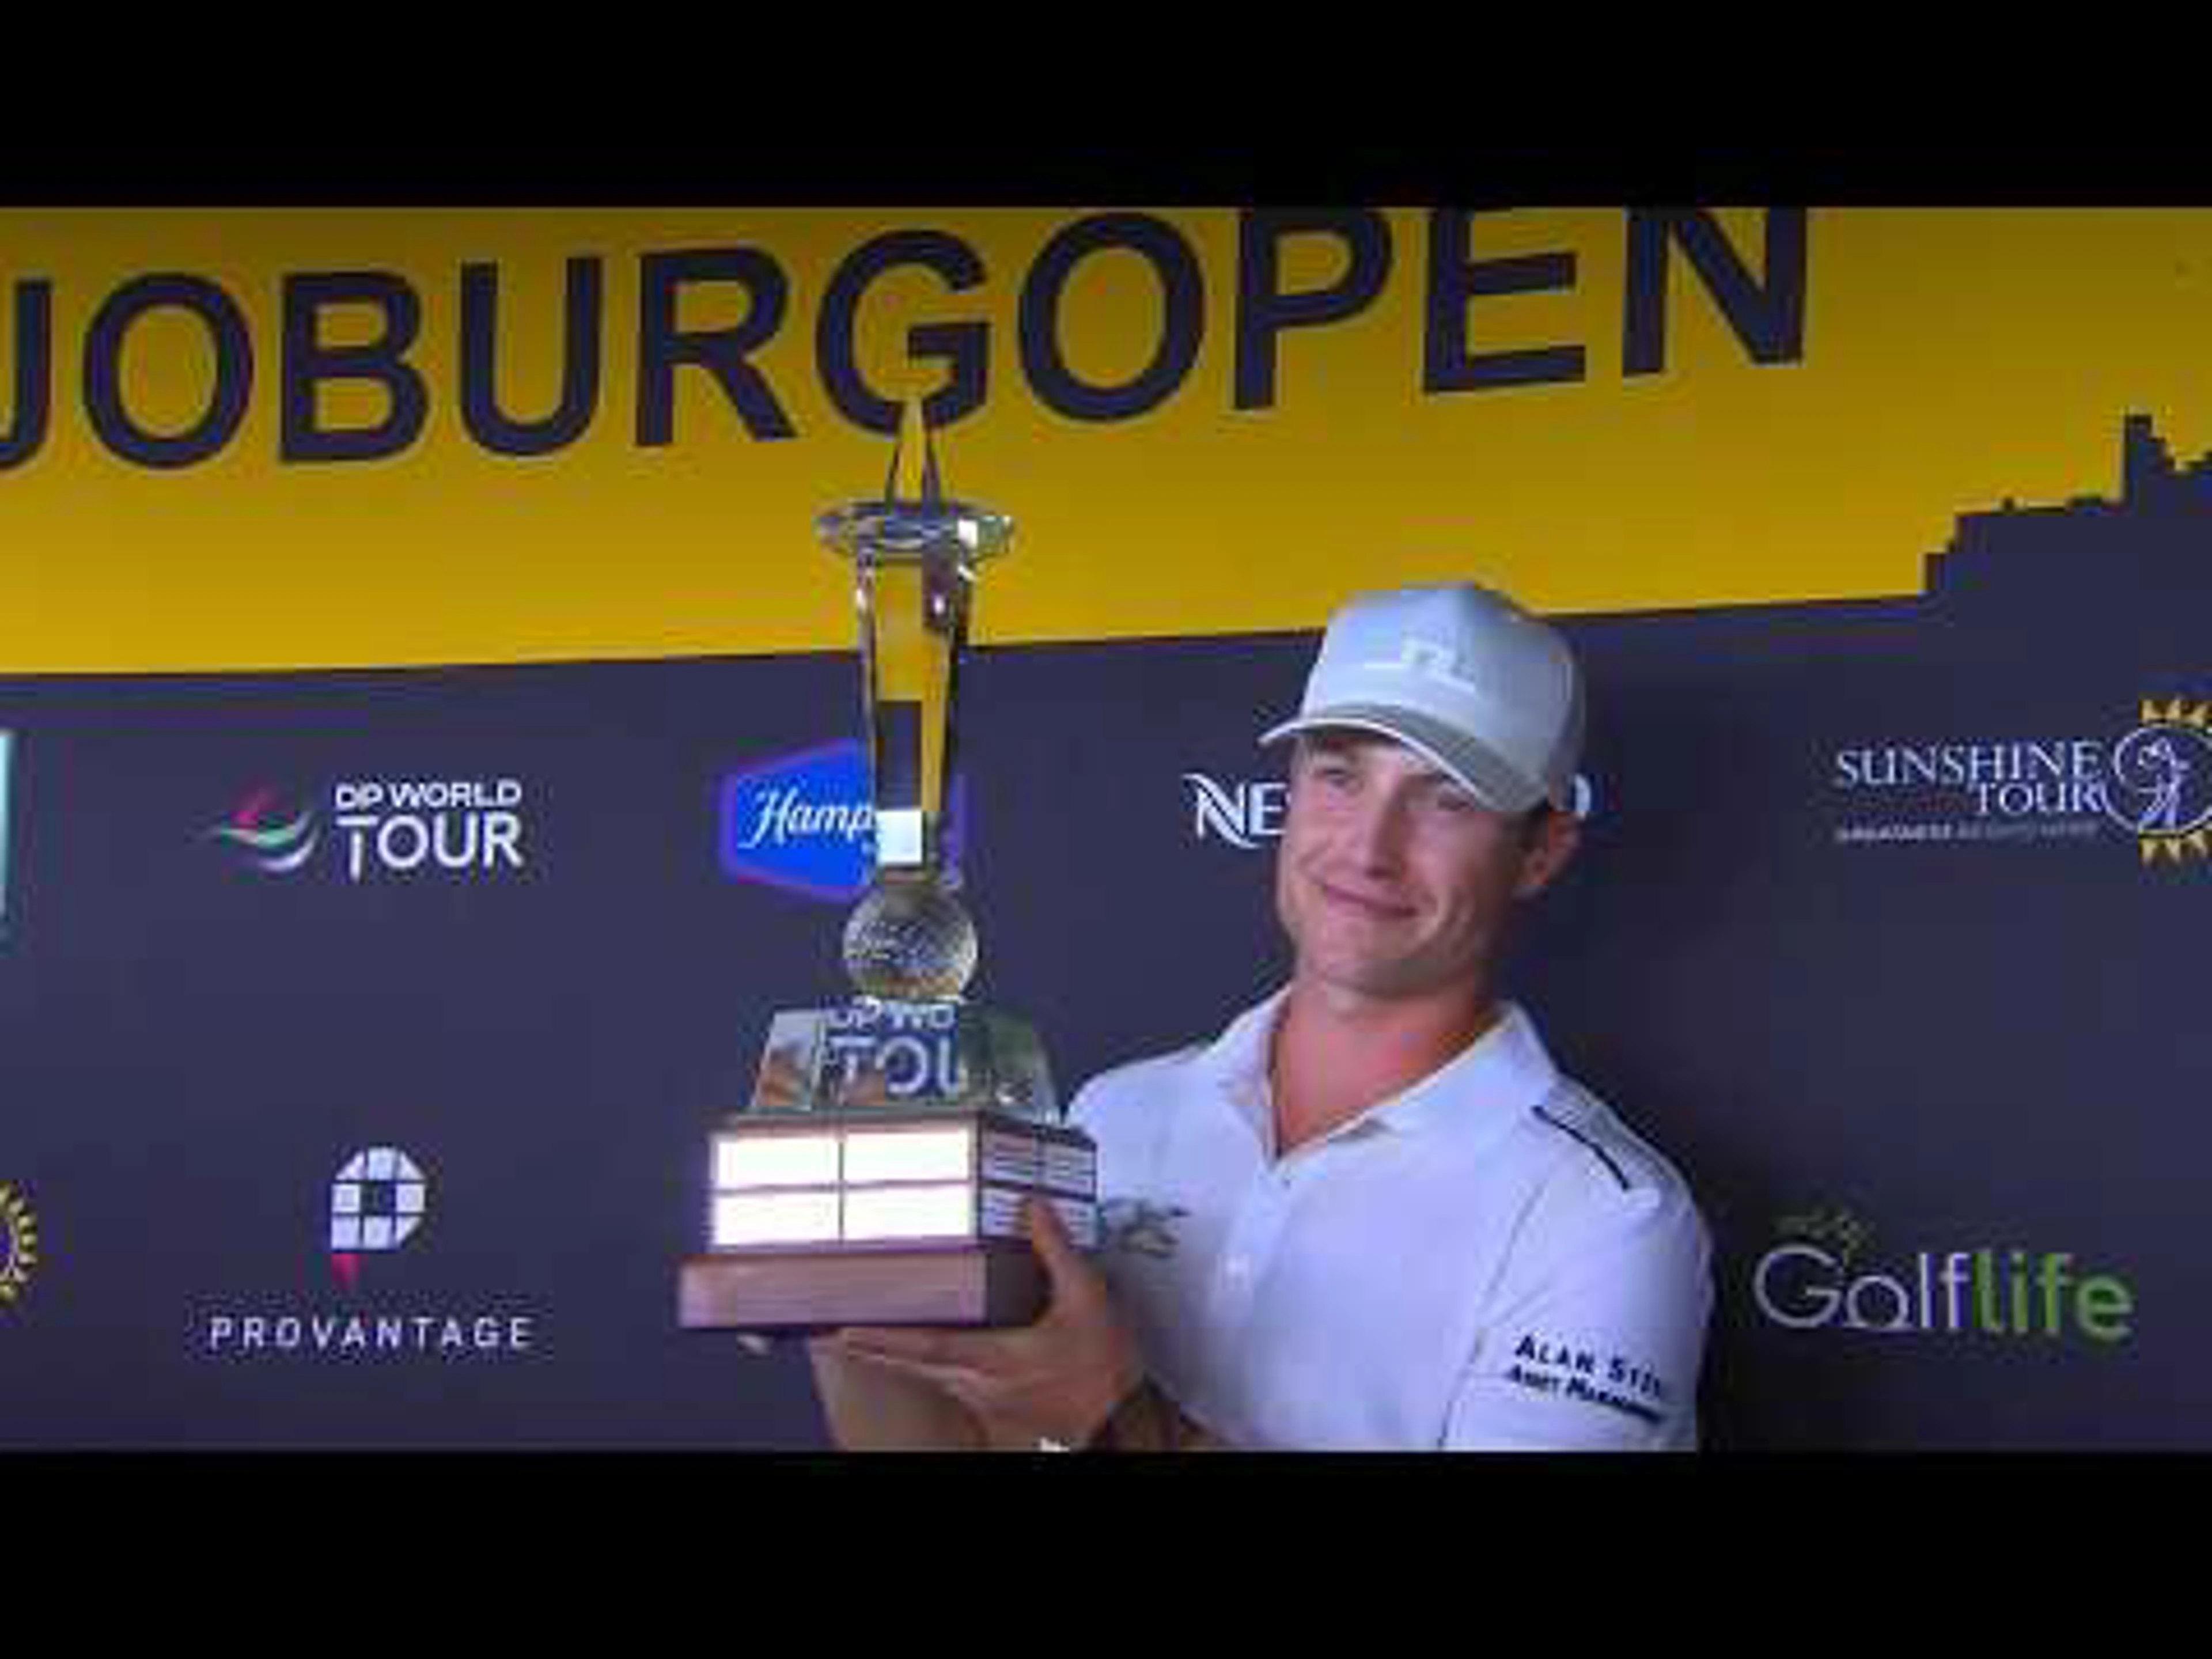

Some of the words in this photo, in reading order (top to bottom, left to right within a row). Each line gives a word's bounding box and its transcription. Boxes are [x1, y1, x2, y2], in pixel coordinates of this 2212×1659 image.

[1836, 742, 2103, 786] SUNSHINE
[336, 781, 384, 808] DP
[389, 779, 521, 808] WORLD
[1975, 779, 2106, 817] TOUR
[736, 786, 876, 847] Hamp
[336, 812, 523, 880] TOUR
[210, 1317, 534, 1349] PROVANTAGE
[1515, 1335, 1596, 1374] ALAN
